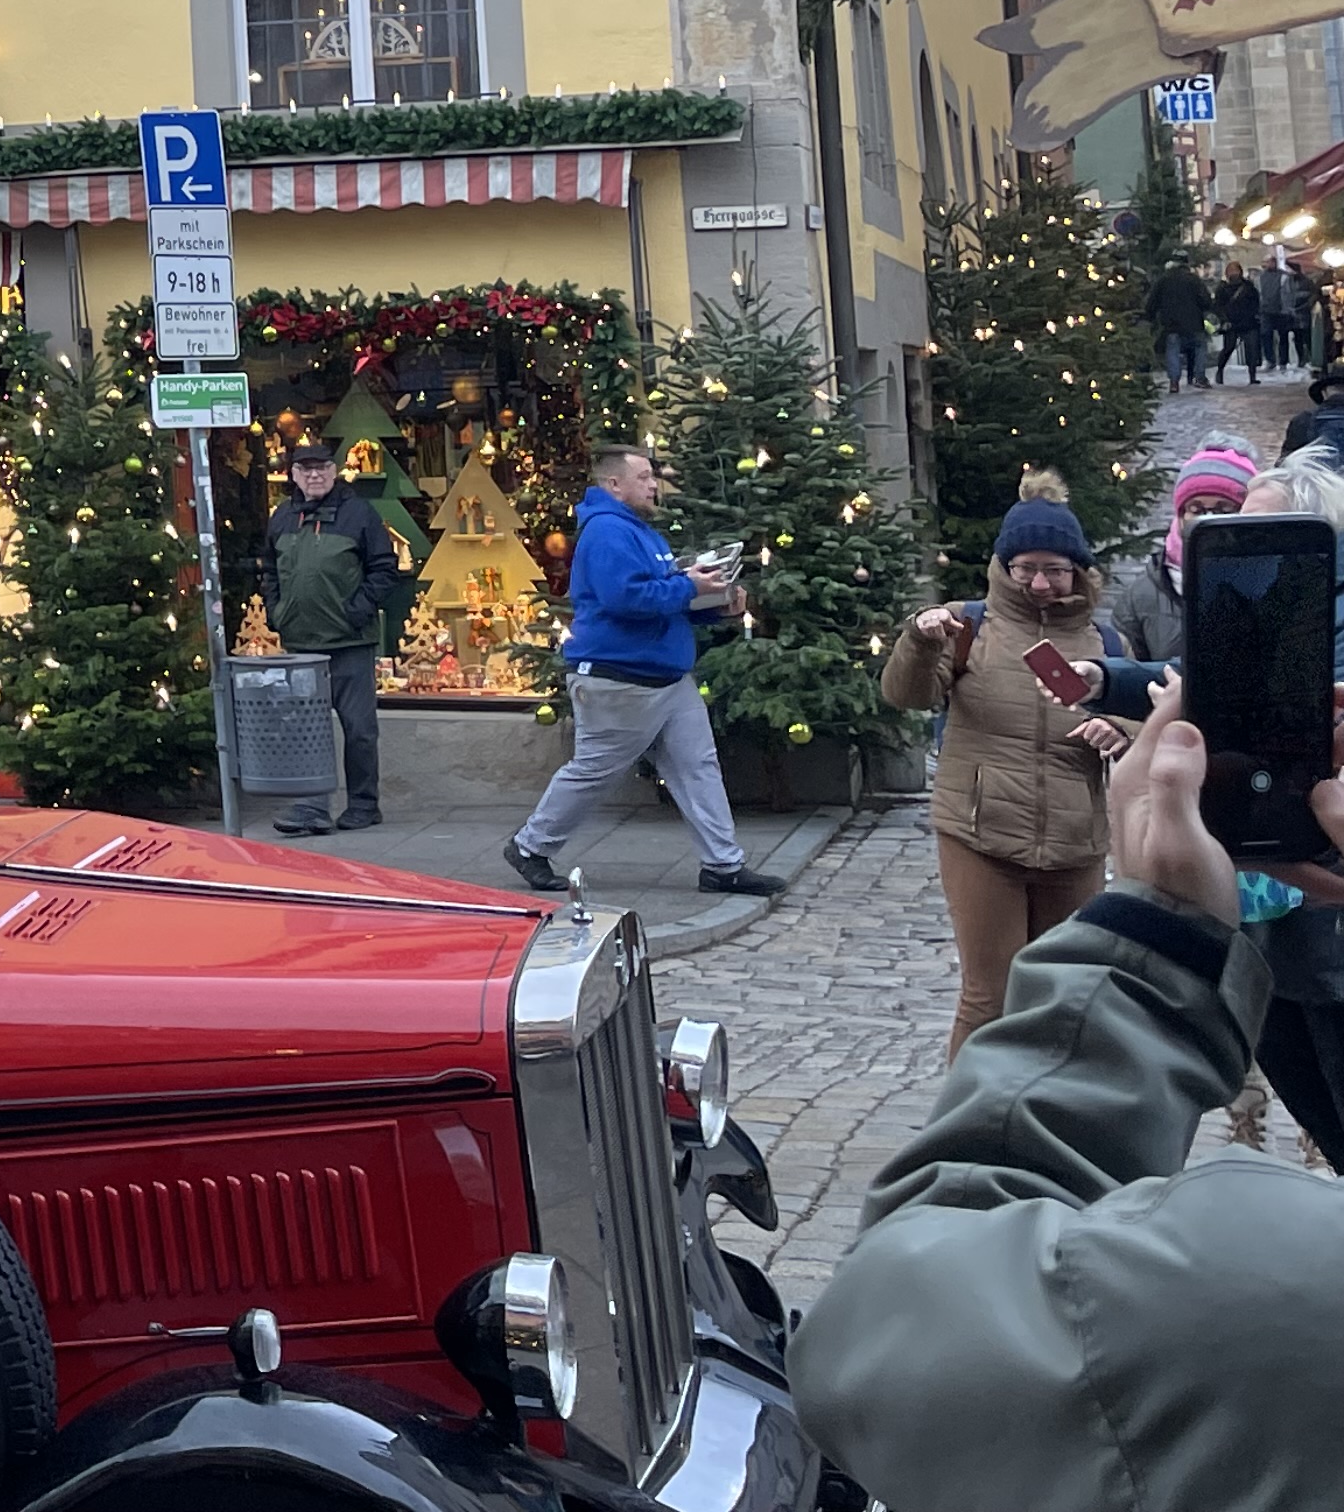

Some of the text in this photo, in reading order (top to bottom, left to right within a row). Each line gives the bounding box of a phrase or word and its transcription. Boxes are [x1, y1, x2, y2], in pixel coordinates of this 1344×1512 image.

[1161, 77, 1210, 92] WC
[154, 125, 198, 202] P
[180, 220, 199, 232] mit
[157, 236, 224, 250] Parkschein
[167, 271, 220, 293] 9-18 h
[165, 307, 226, 321] Bewohner
[187, 338, 208, 353] frei
[160, 379, 244, 395] Handy-Parken
